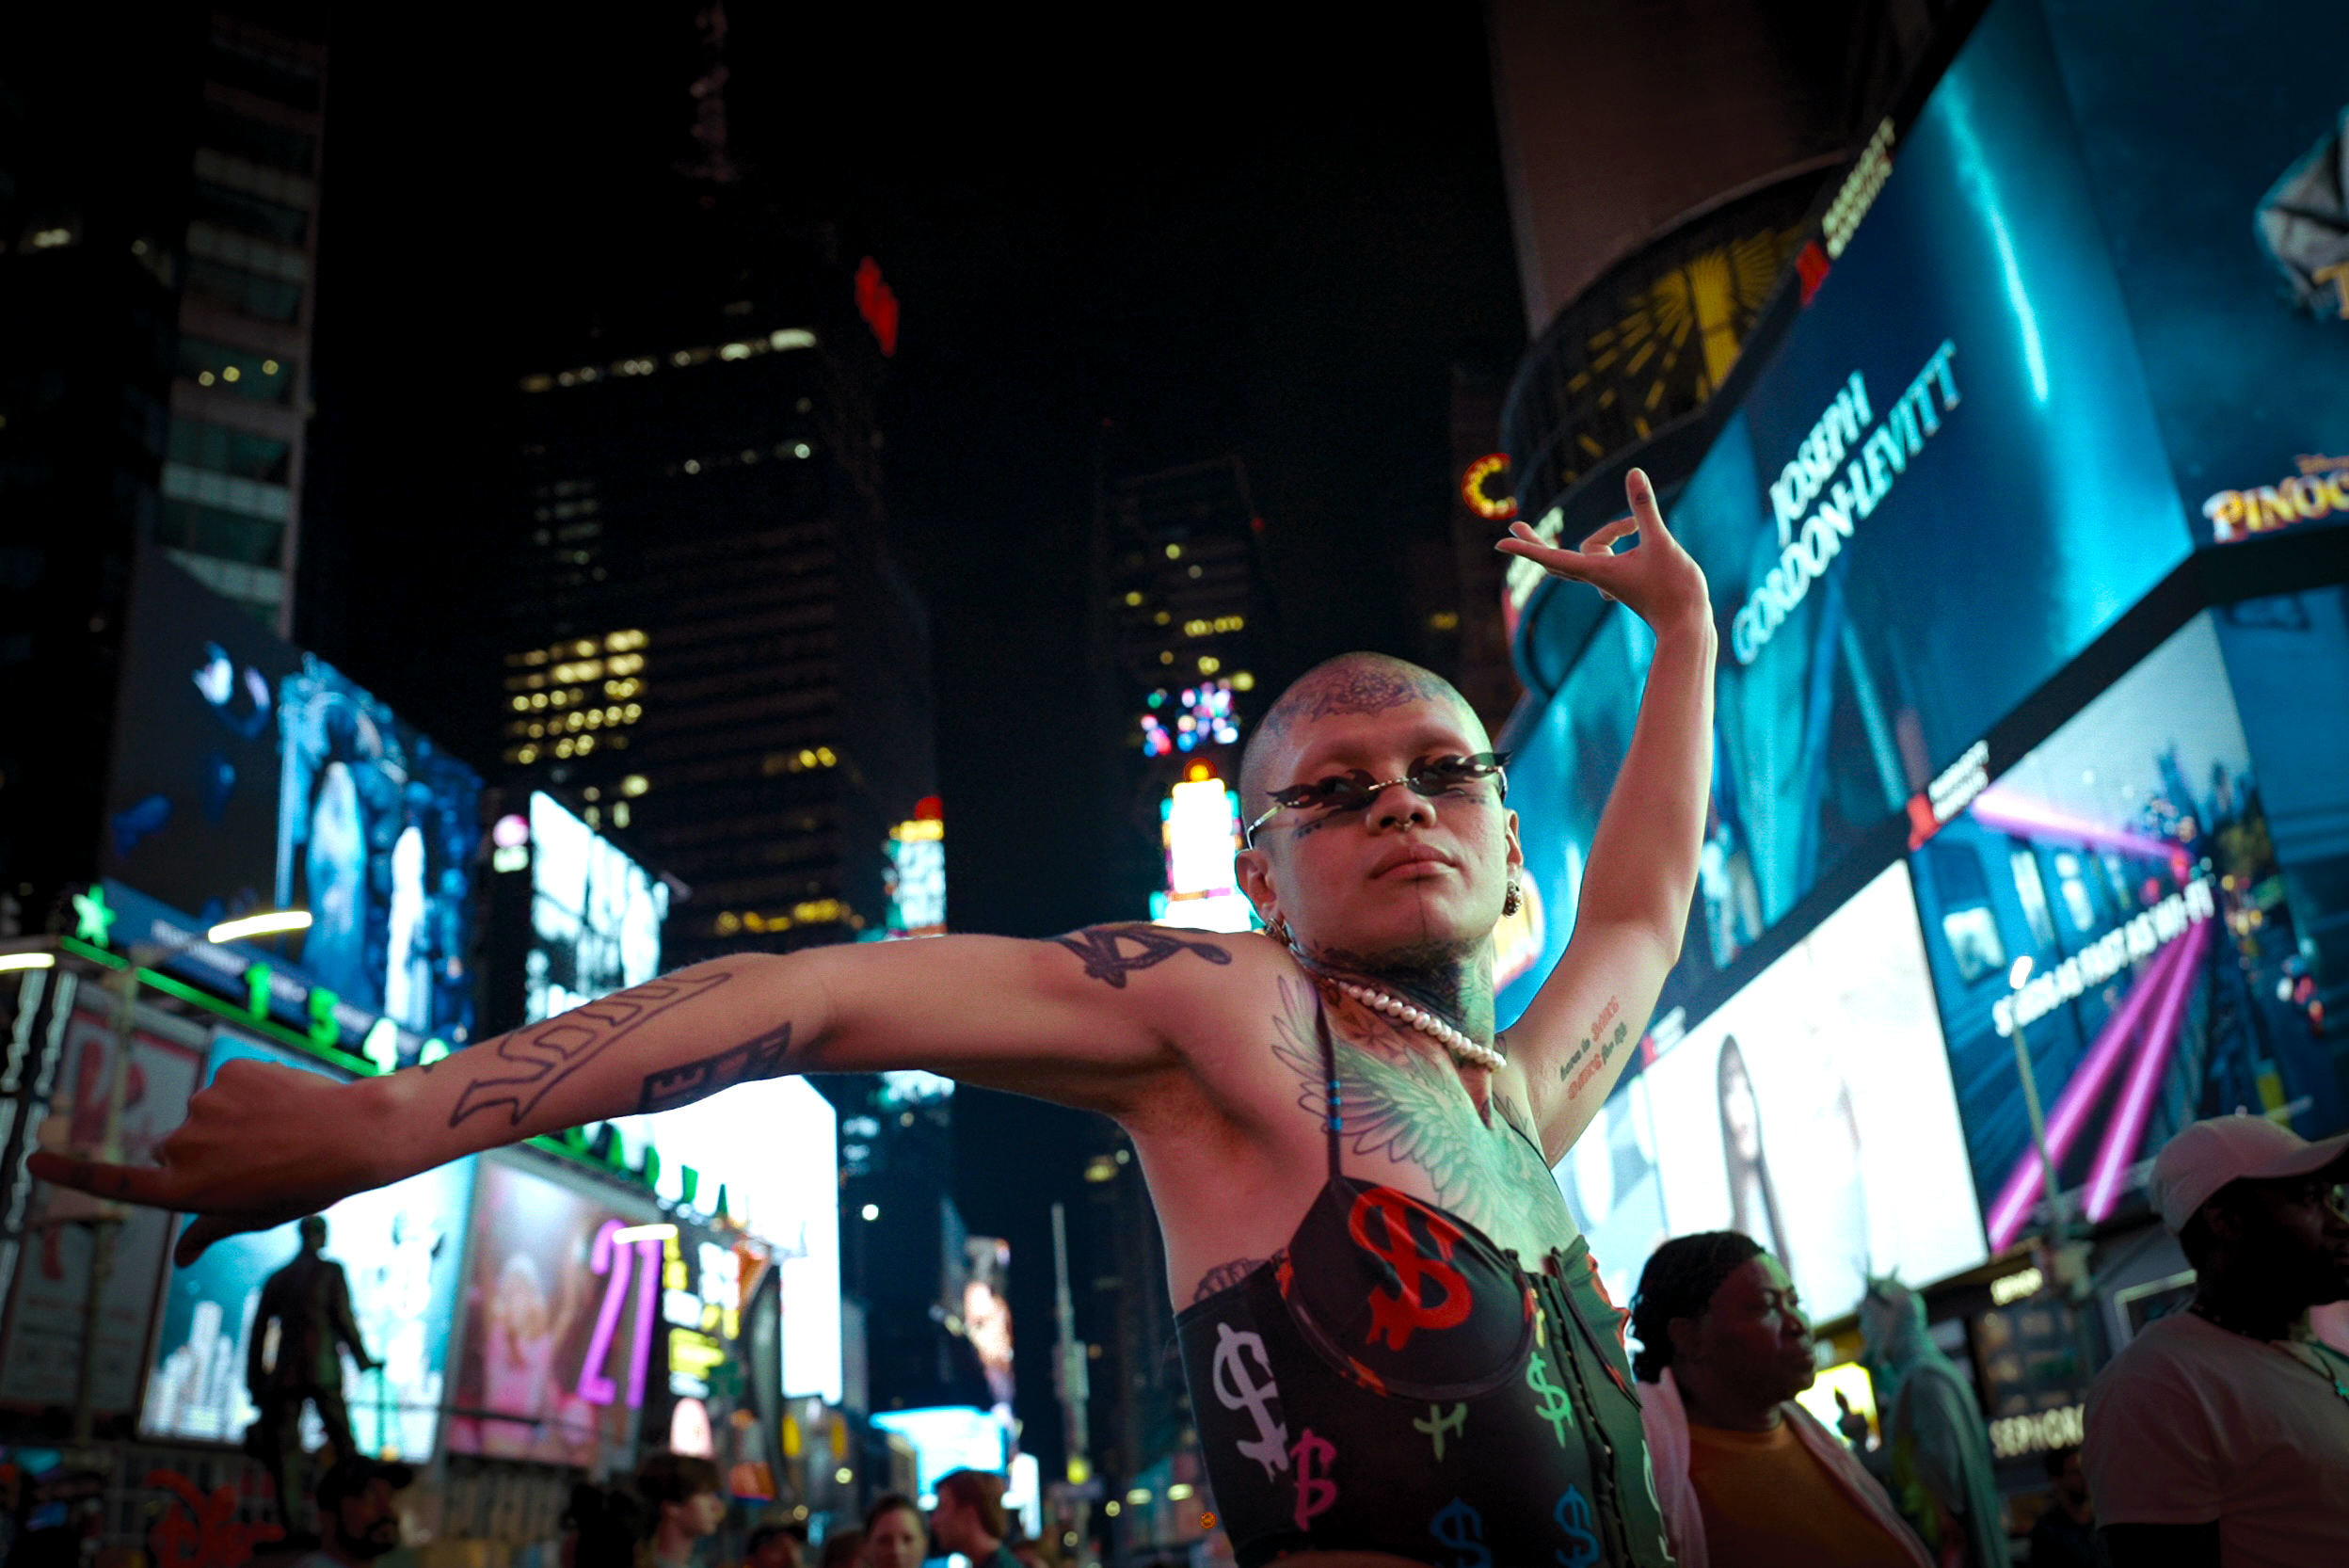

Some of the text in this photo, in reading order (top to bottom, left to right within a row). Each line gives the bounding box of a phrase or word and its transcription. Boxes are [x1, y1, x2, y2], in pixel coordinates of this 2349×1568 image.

[1732, 337, 1961, 664] GORDON-LEVITT
[1769, 369, 1874, 548] JOSEPH
[575, 1219, 664, 1410] 21
